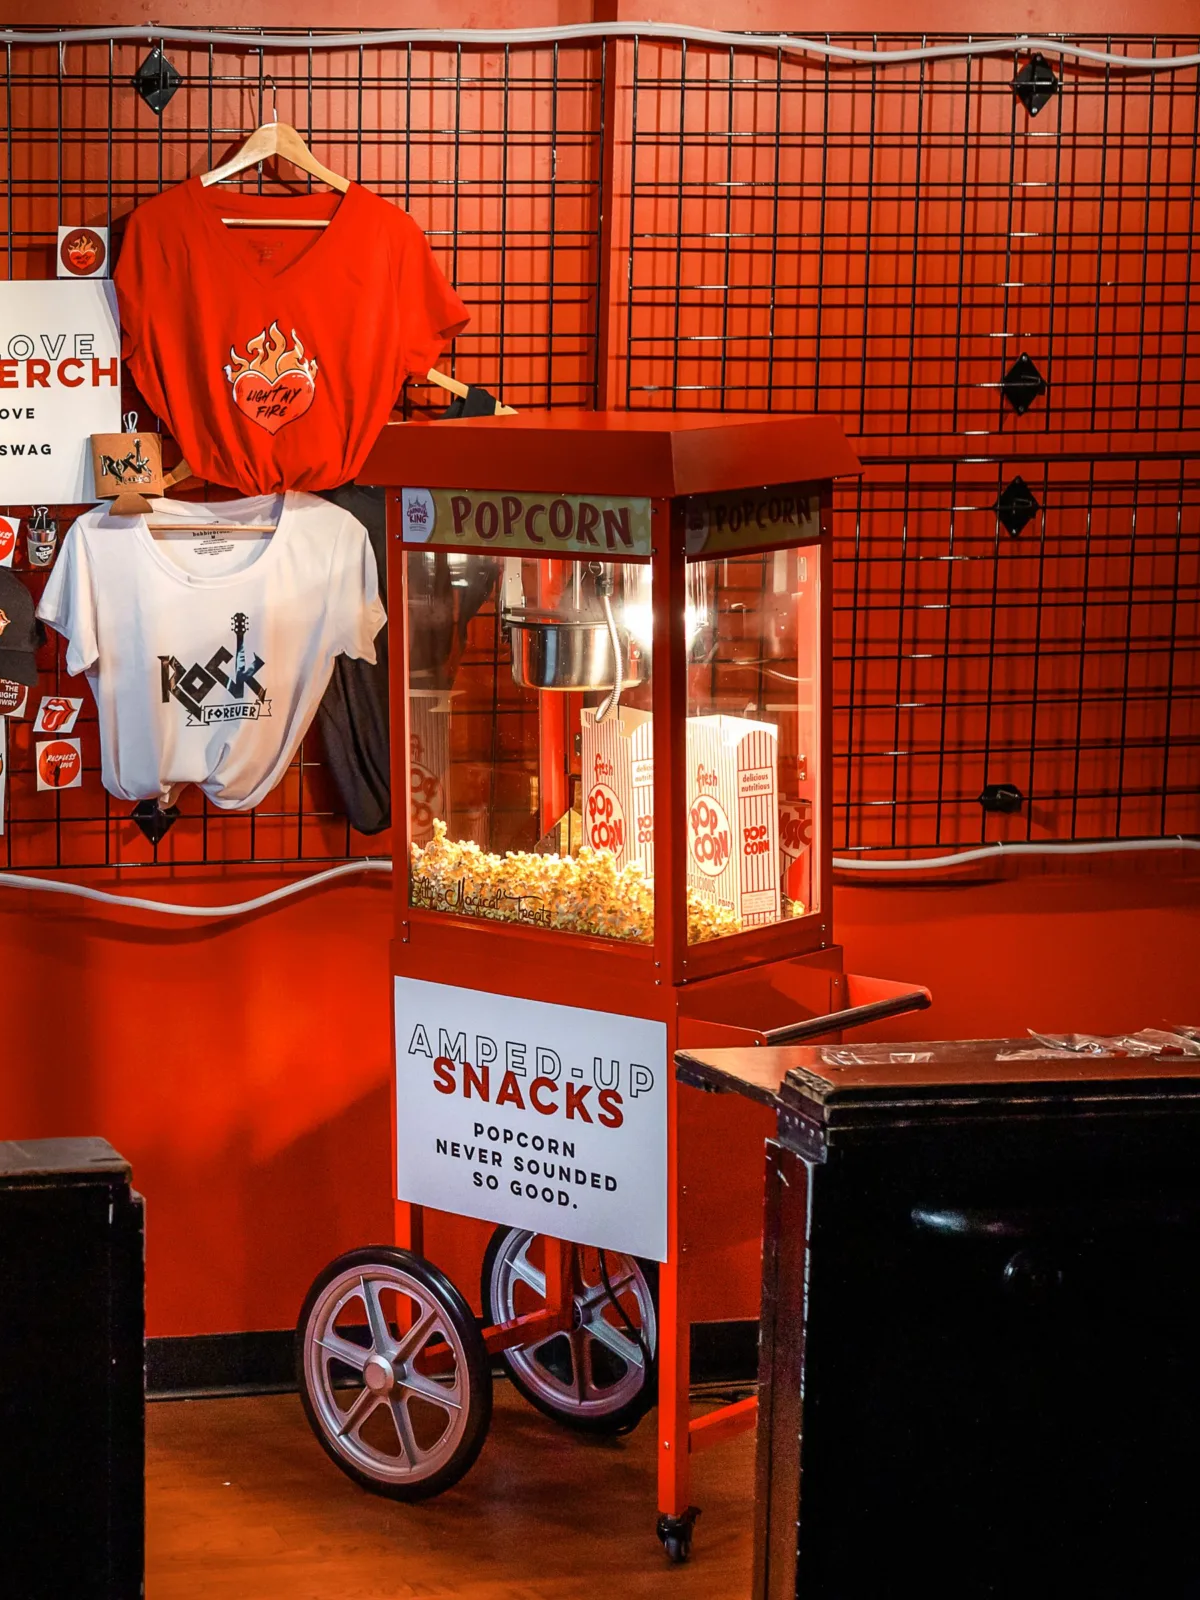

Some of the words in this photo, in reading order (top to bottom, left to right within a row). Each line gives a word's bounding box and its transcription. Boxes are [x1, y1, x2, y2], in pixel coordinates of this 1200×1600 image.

[246, 385, 286, 402] LIGHT
[280, 387, 302, 403] MY
[256, 404, 287, 418] FIRE
[451, 495, 635, 550] POPCORN
[715, 498, 812, 534] POPCORN
[158, 612, 267, 722] ROCK
[207, 706, 256, 719] FOREVER
[696, 763, 718, 793] fresh
[741, 783, 771, 793] nutritious
[742, 773, 769, 783] delicious
[589, 790, 613, 823] POP
[637, 815, 653, 830] PO
[690, 801, 718, 836] POP
[591, 820, 623, 853] CORN
[694, 830, 729, 866] CORN
[743, 825, 767, 842] POP
[744, 840, 770, 856] CORN
[504, 890, 551, 923] Treats
[408, 1024, 654, 1098] AMPED-UP
[433, 1056, 624, 1129] SNACKS
[473, 1122, 575, 1158] POPCORN
[436, 1139, 502, 1167] NEVER
[513, 1156, 618, 1192] SOUNDED
[472, 1172, 499, 1190] SO
[510, 1180, 578, 1210] GOOD.
